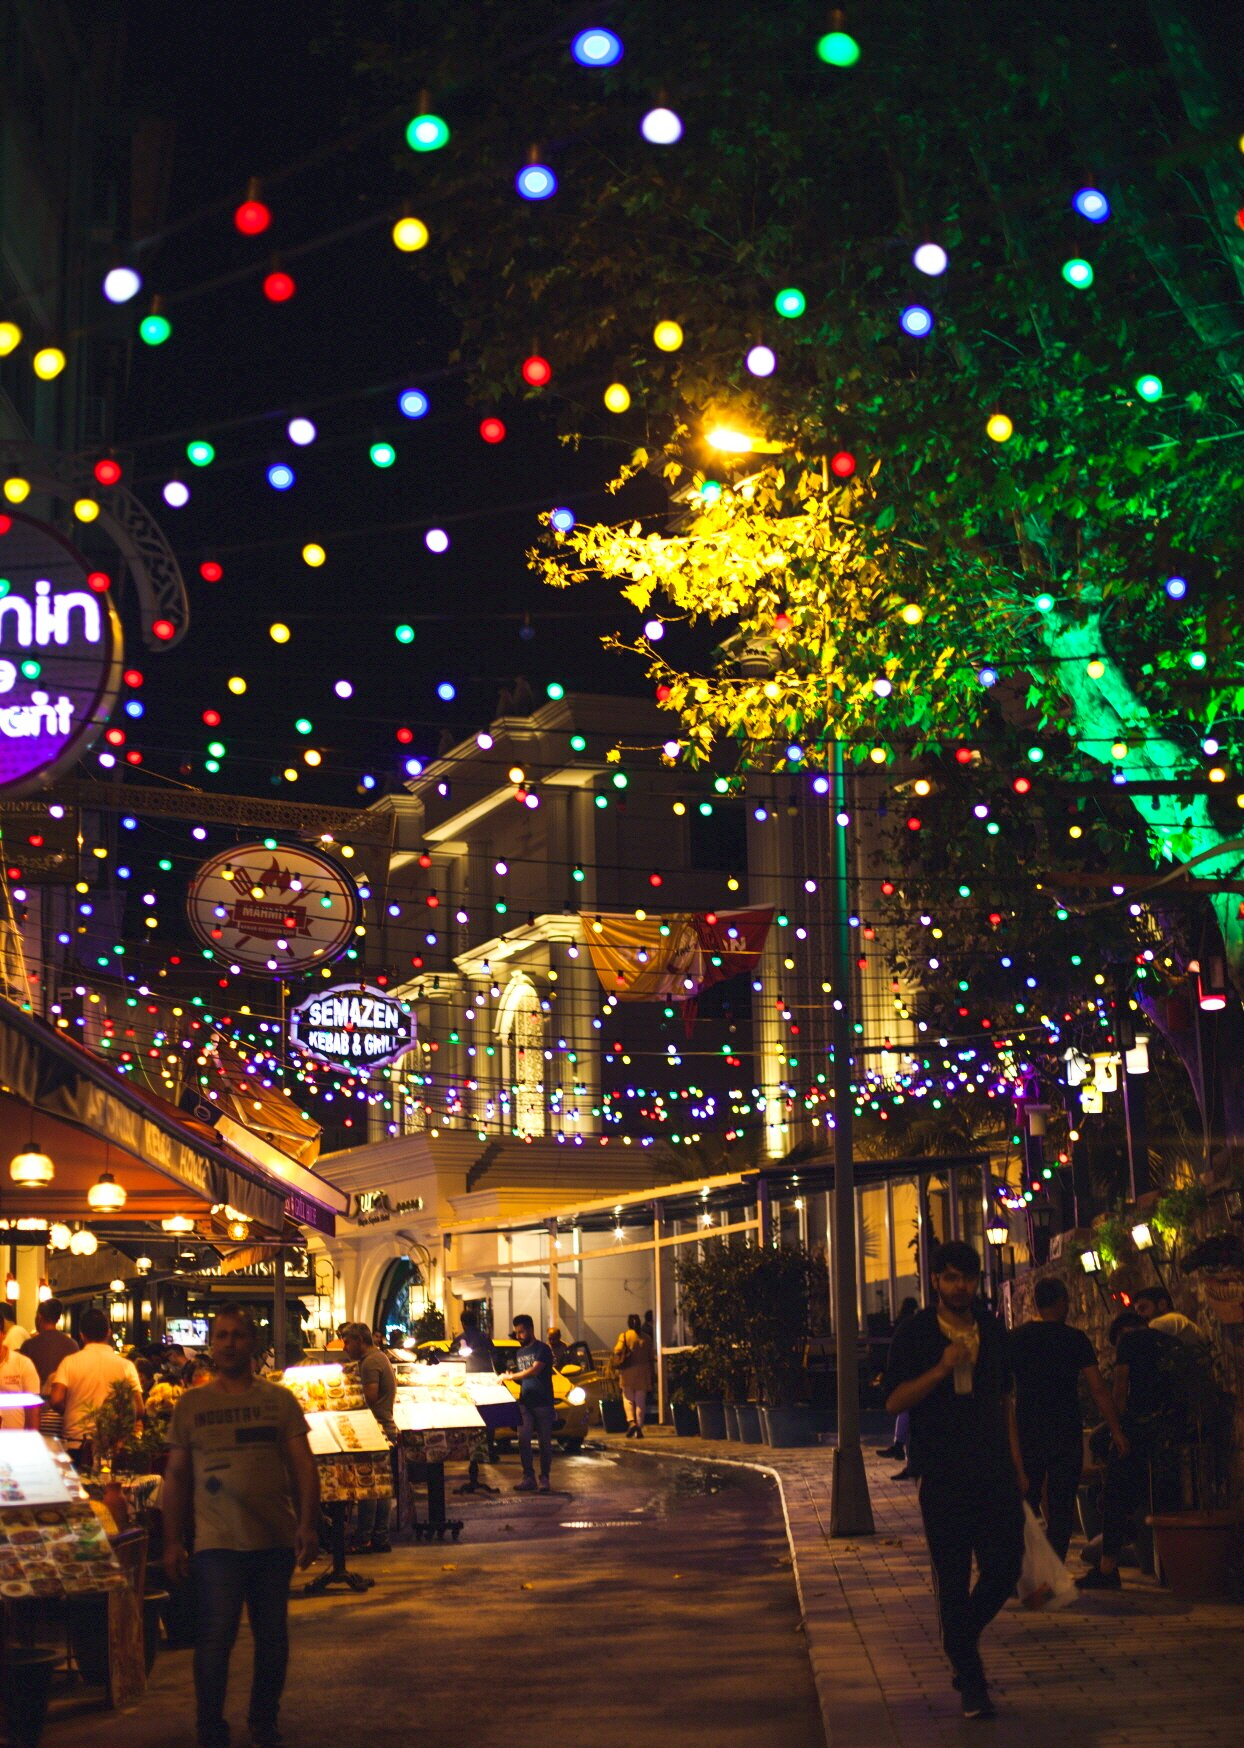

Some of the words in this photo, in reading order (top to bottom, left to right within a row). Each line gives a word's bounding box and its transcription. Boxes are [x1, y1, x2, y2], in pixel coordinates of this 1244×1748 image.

[309, 997, 399, 1029] SEMAZEN
[308, 1031, 350, 1056] KEBAB
[352, 1032, 362, 1056] &
[364, 1033, 399, 1055] GRILL
